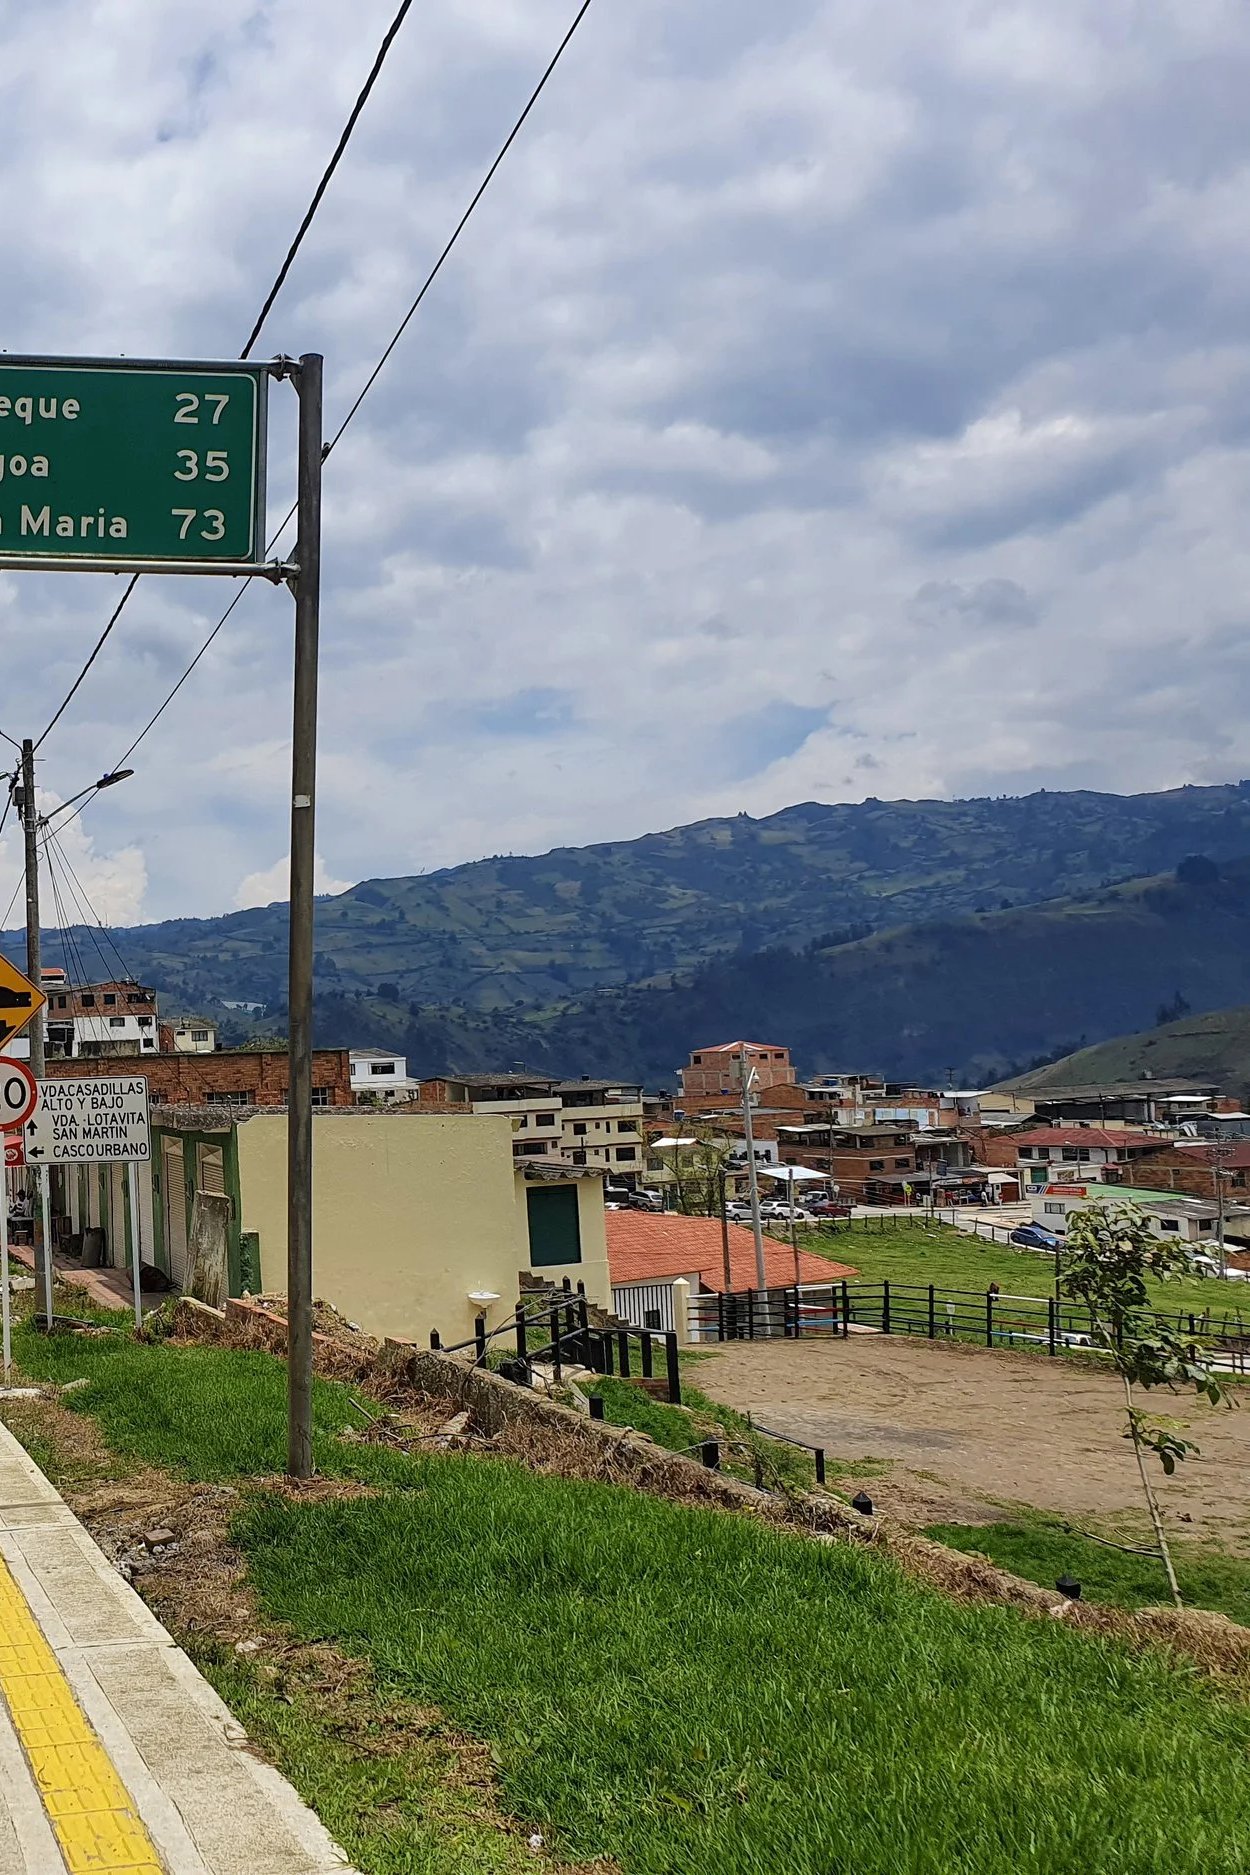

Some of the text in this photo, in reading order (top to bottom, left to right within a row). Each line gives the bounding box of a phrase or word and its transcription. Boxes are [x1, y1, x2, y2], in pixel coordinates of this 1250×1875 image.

[173, 393, 230, 425] 27
[173, 449, 230, 482] 35
[20, 505, 129, 539] Maria
[171, 508, 227, 541] 73
[41, 1096, 124, 1111] ALTO Y BAJO
[52, 1112, 146, 1127] VDA. LOTAVITA
[53, 1125, 128, 1140] SAN MARTIN
